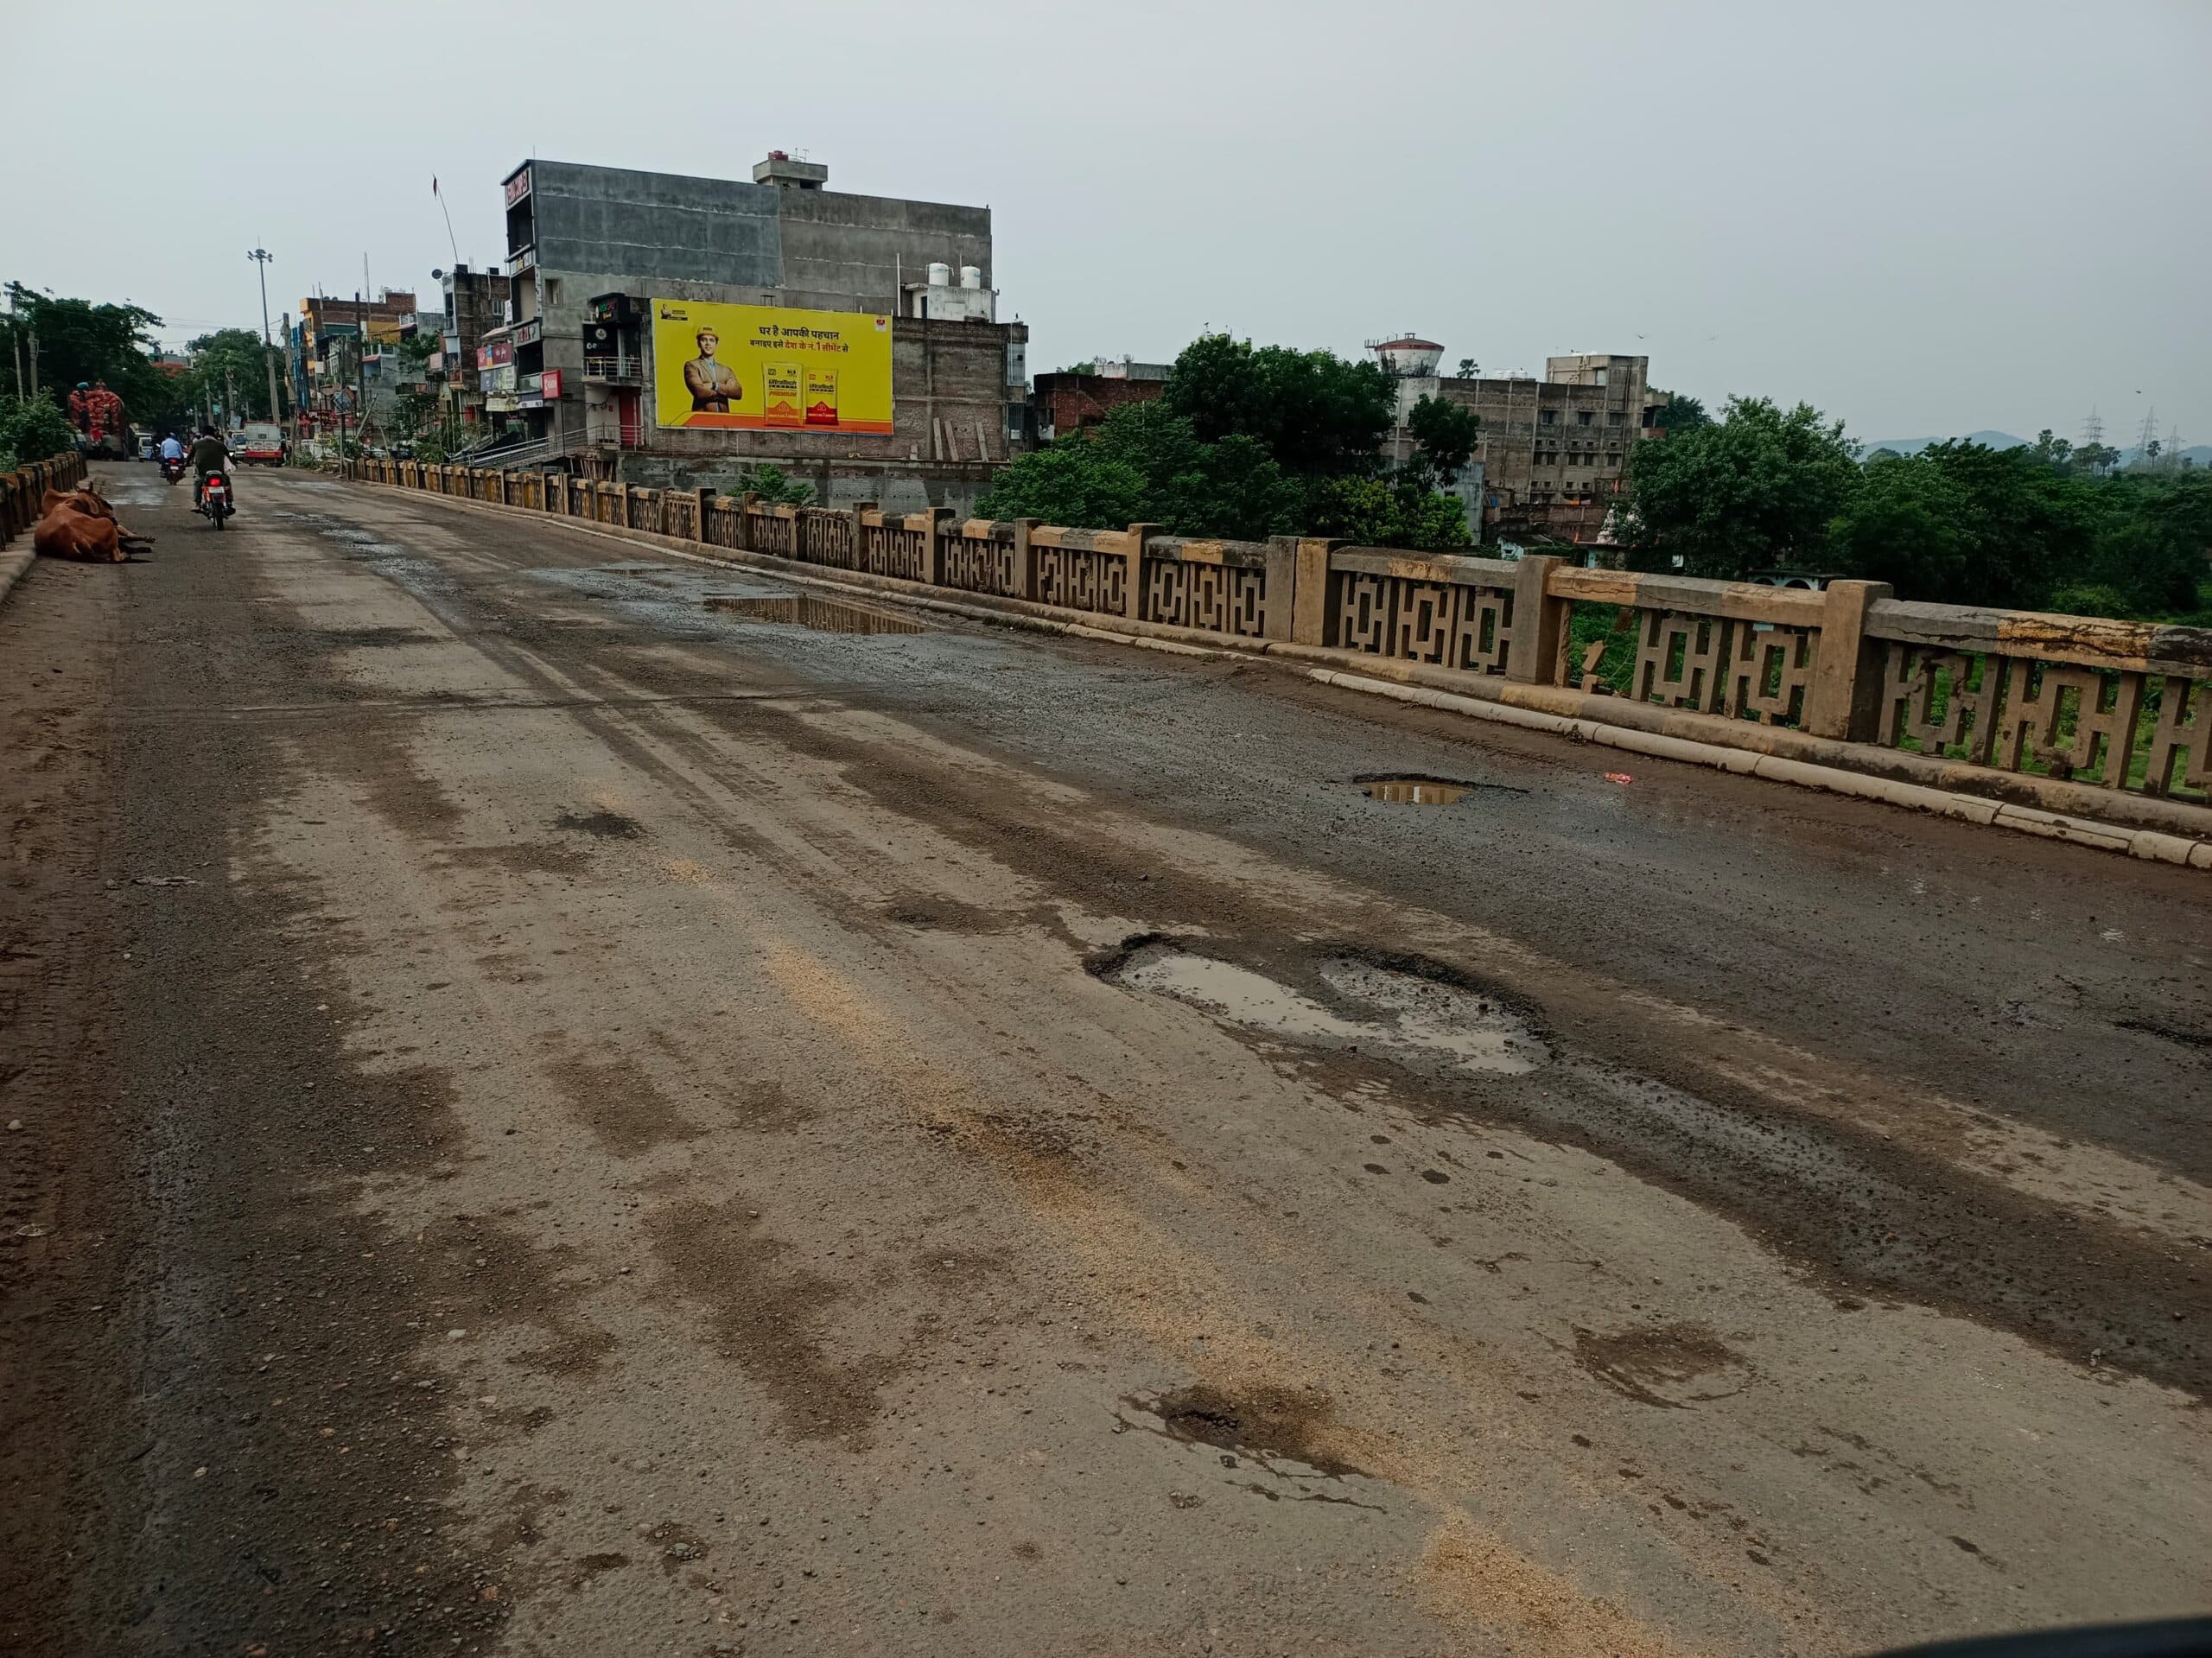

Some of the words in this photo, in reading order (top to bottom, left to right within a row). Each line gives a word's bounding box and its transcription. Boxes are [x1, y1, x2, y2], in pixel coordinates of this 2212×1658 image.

[760, 327, 770, 335] घर
[773, 325, 779, 336] है
[781, 327, 809, 338] आपकी
[811, 330, 839, 340] पहचान
[799, 340, 807, 350] के
[842, 344, 849, 353] से
